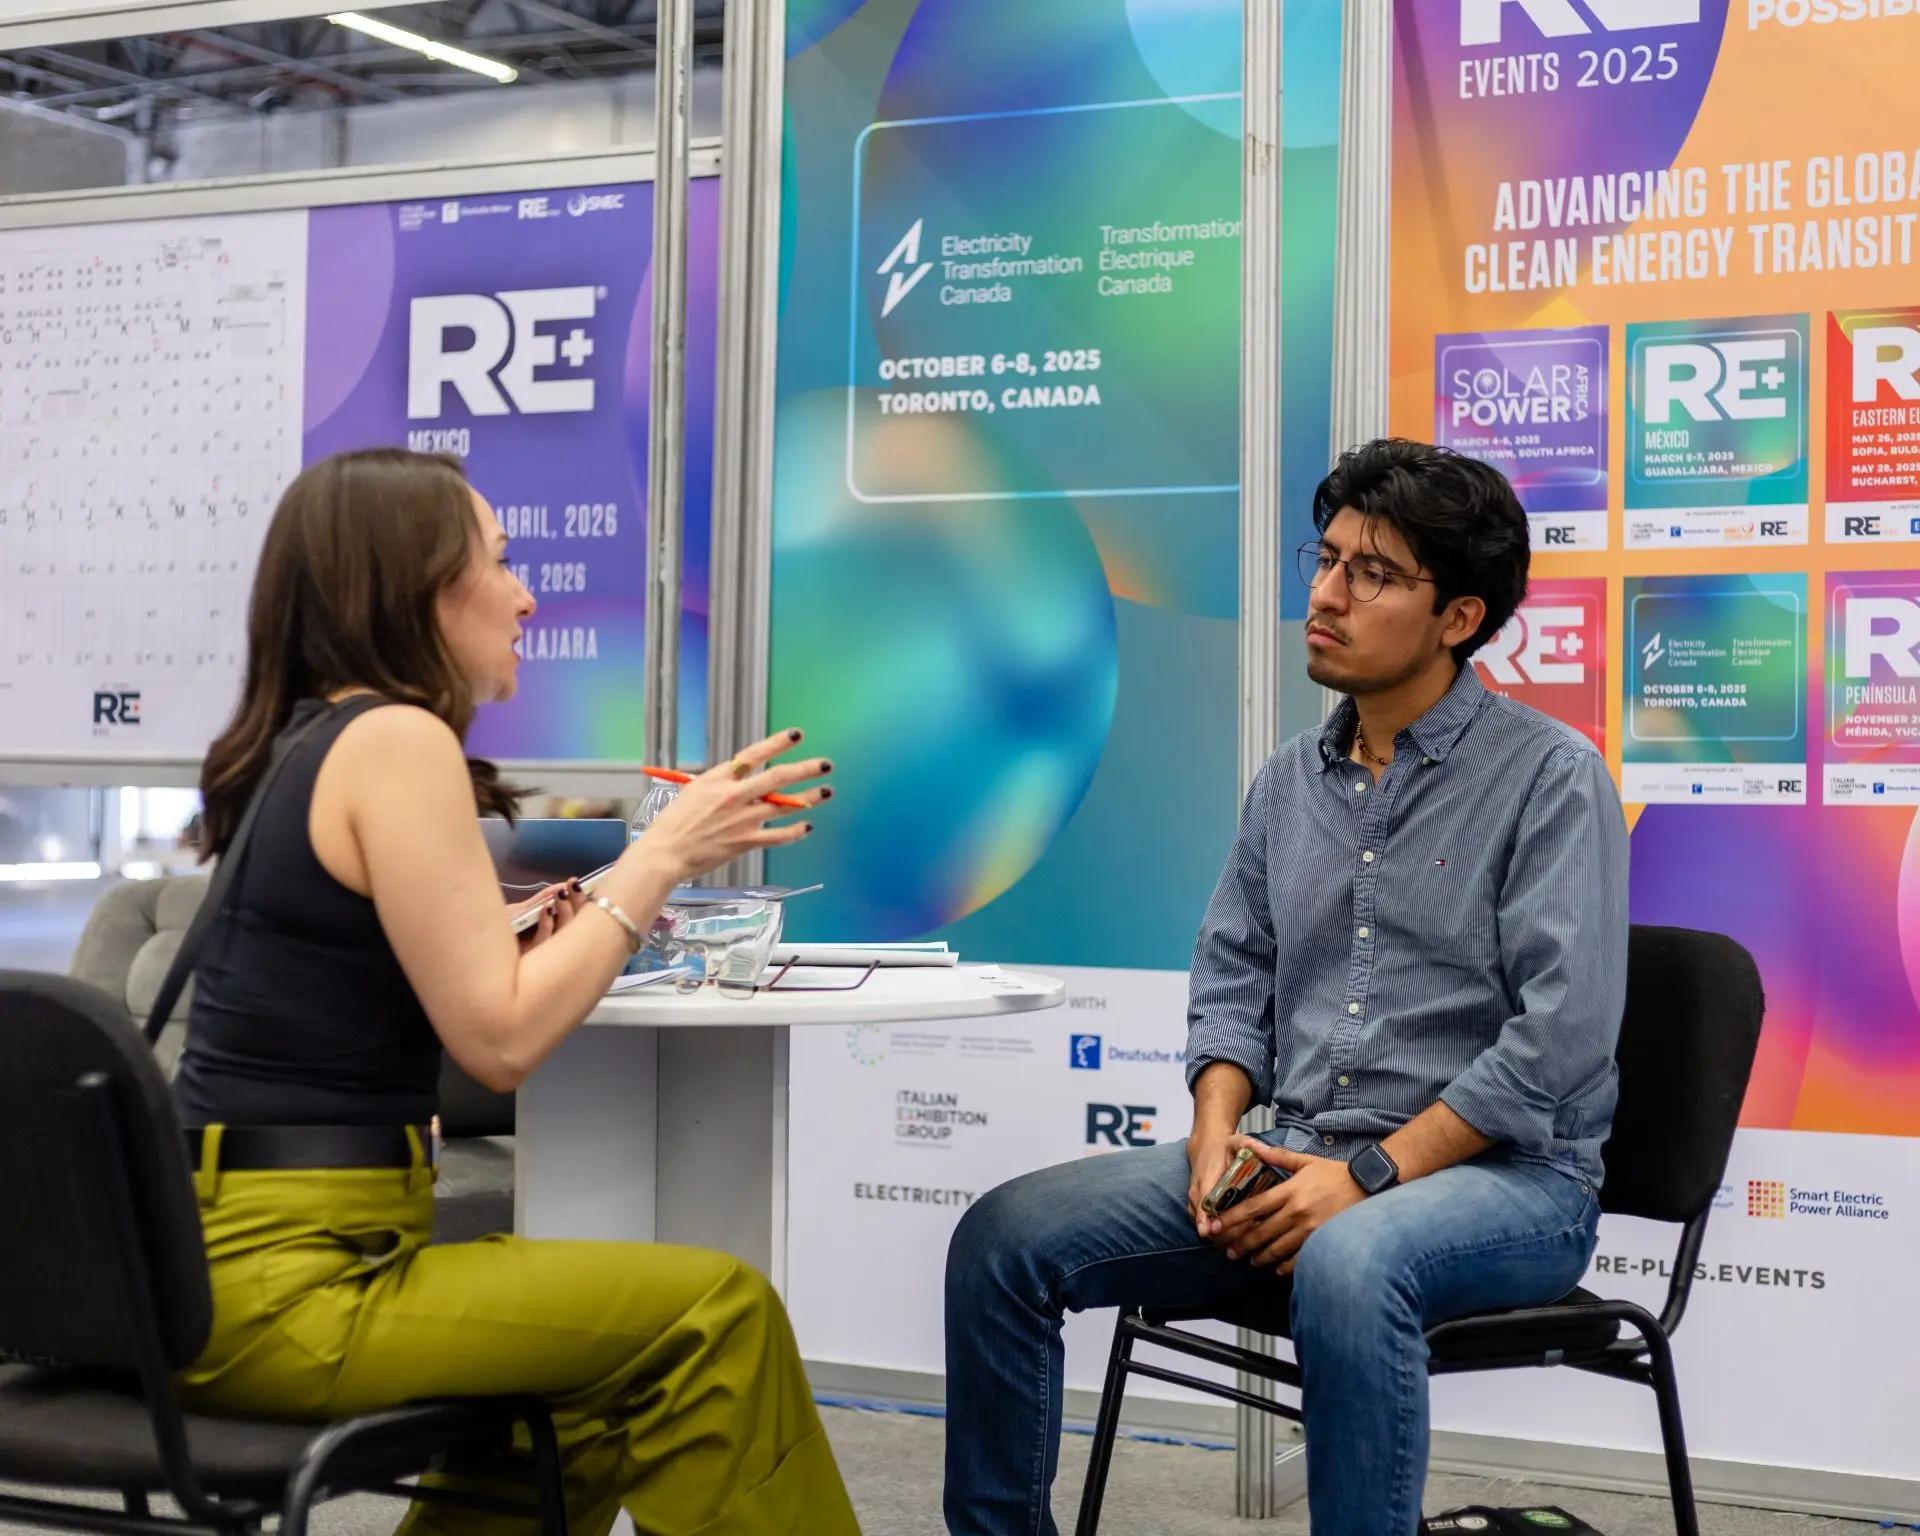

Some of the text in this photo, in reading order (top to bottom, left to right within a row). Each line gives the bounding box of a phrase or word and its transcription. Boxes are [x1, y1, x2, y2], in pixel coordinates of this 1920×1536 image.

[1459, 42, 1679, 99] EVENTS 2025
[1494, 166, 1707, 232] ADVANCING
[1722, 159, 1791, 214] THE
[941, 231, 1033, 258] Electricity
[1464, 213, 1919, 295] CLEAN ENERGY TRANSIT
[941, 255, 1083, 281] Transformation
[1098, 246, 1195, 271] Électrique
[940, 285, 1012, 307] Canada
[1098, 275, 1172, 297] Canada
[879, 349, 1101, 381] OCTOBER 6-8, 2025
[1453, 364, 1571, 400] SOLAR
[879, 384, 1101, 415] TORONTO, CANADA
[1575, 364, 1589, 422] AFRICA
[1452, 396, 1571, 427] POWER
[1852, 408, 1906, 428] EASTERN
[1645, 429, 1689, 450] MÉXICO
[1852, 434, 1874, 444] MAY
[1519, 448, 1553, 458] SOUTH
[1555, 446, 1595, 456] AFRICA
[1645, 453, 1683, 464] MARCH
[1708, 451, 1734, 462] 2025
[1852, 446, 1920, 457] SOFIA, BULG
[1645, 465, 1728, 477] GUADALAJARA,
[1852, 464, 1874, 473] MAY
[1852, 476, 1918, 487] BUCHAREST,
[564, 503, 618, 537] 2026
[541, 562, 586, 592] 2026
[1643, 684, 1694, 694] OCTOBER
[1720, 684, 1747, 693] 2025
[1846, 683, 1917, 705] PENÍNSULA
[1643, 697, 1747, 709] TORONTO, CANADA
[1846, 714, 1908, 725] NOVEMBER
[1846, 725, 1920, 737] MÉRIDA, YUC
[1069, 997, 1107, 1010] WITH
[1108, 1047, 1171, 1062] Deutsche
[896, 1089, 958, 1107] ITALIAN
[895, 1124, 953, 1140] GROUP
[1790, 1187, 1884, 1206] Smart Electric
[1790, 1202, 1889, 1220] Power Alliance
[1596, 1254, 1826, 1290] RE-PLS.EVENTS
